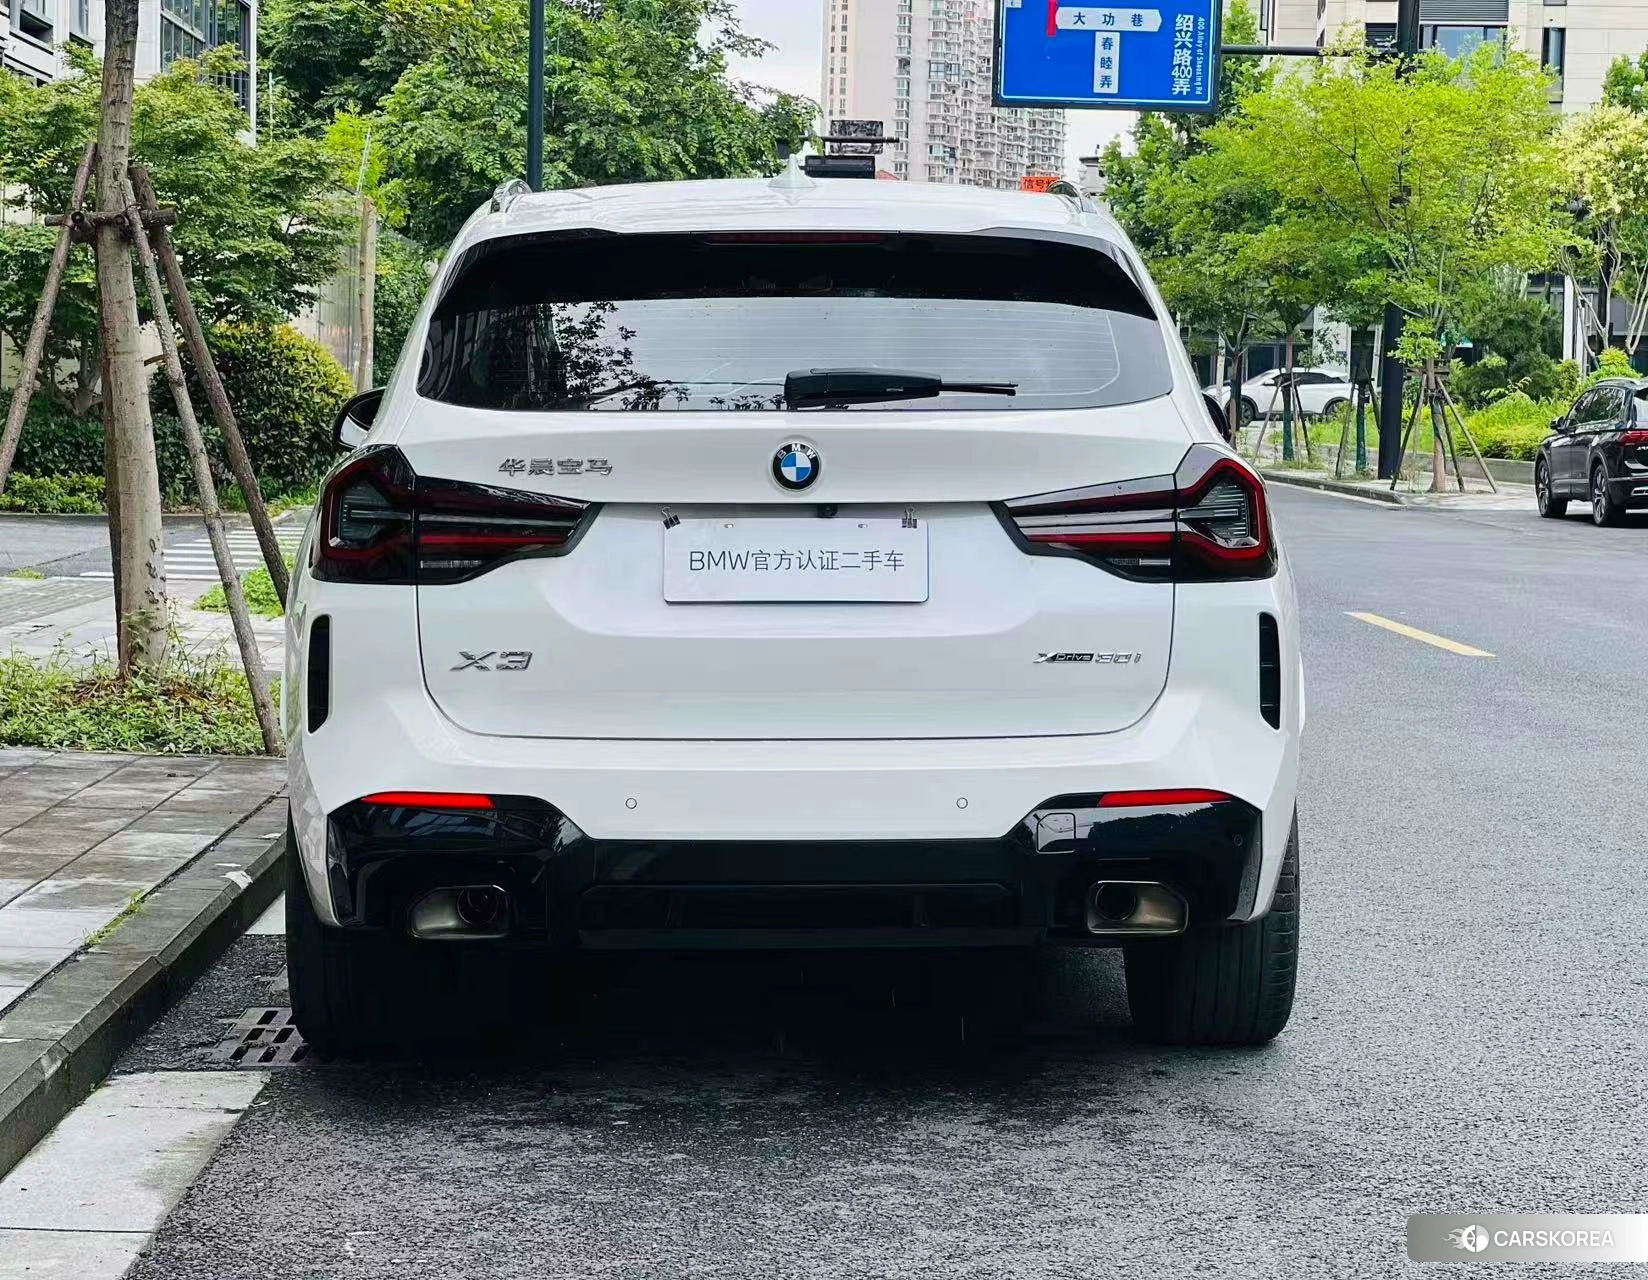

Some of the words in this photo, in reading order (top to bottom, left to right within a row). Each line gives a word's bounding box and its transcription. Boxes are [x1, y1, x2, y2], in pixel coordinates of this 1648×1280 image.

[1073, 12, 1143, 27] 大功巷
[1197, 17, 1206, 30] 400
[1100, 37, 1113, 88] 春睦弄
[1172, 14, 1194, 95] 绍兴路400弄
[776, 443, 817, 460] BMW
[498, 458, 613, 477] 华晨宝马
[689, 549, 905, 571] BMW官方认证二手车
[449, 650, 534, 671] X3
